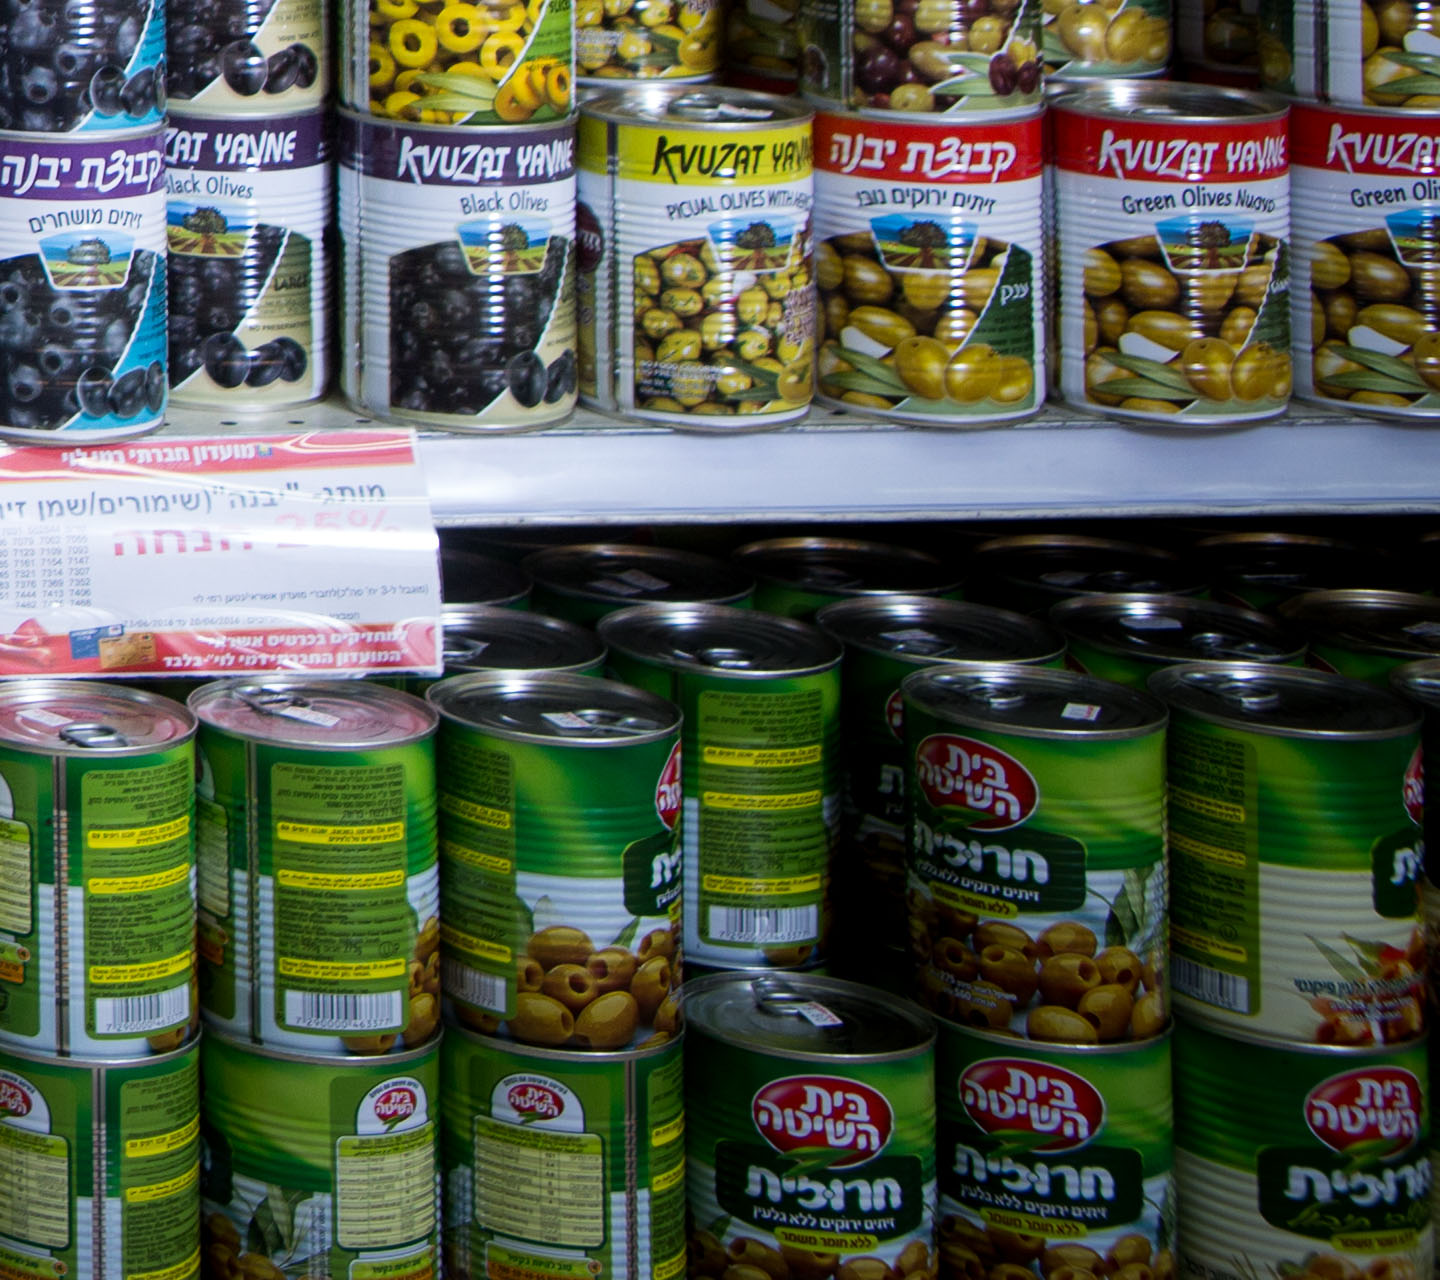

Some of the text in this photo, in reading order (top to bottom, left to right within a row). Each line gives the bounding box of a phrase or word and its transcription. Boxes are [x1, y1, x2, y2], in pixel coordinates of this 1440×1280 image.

[830, 132, 1018, 183] קבוצת יבנה
[757, 1099, 880, 1152] השיטה
[800, 1083, 871, 1123] בית
[745, 1162, 903, 1212] חרוזית
